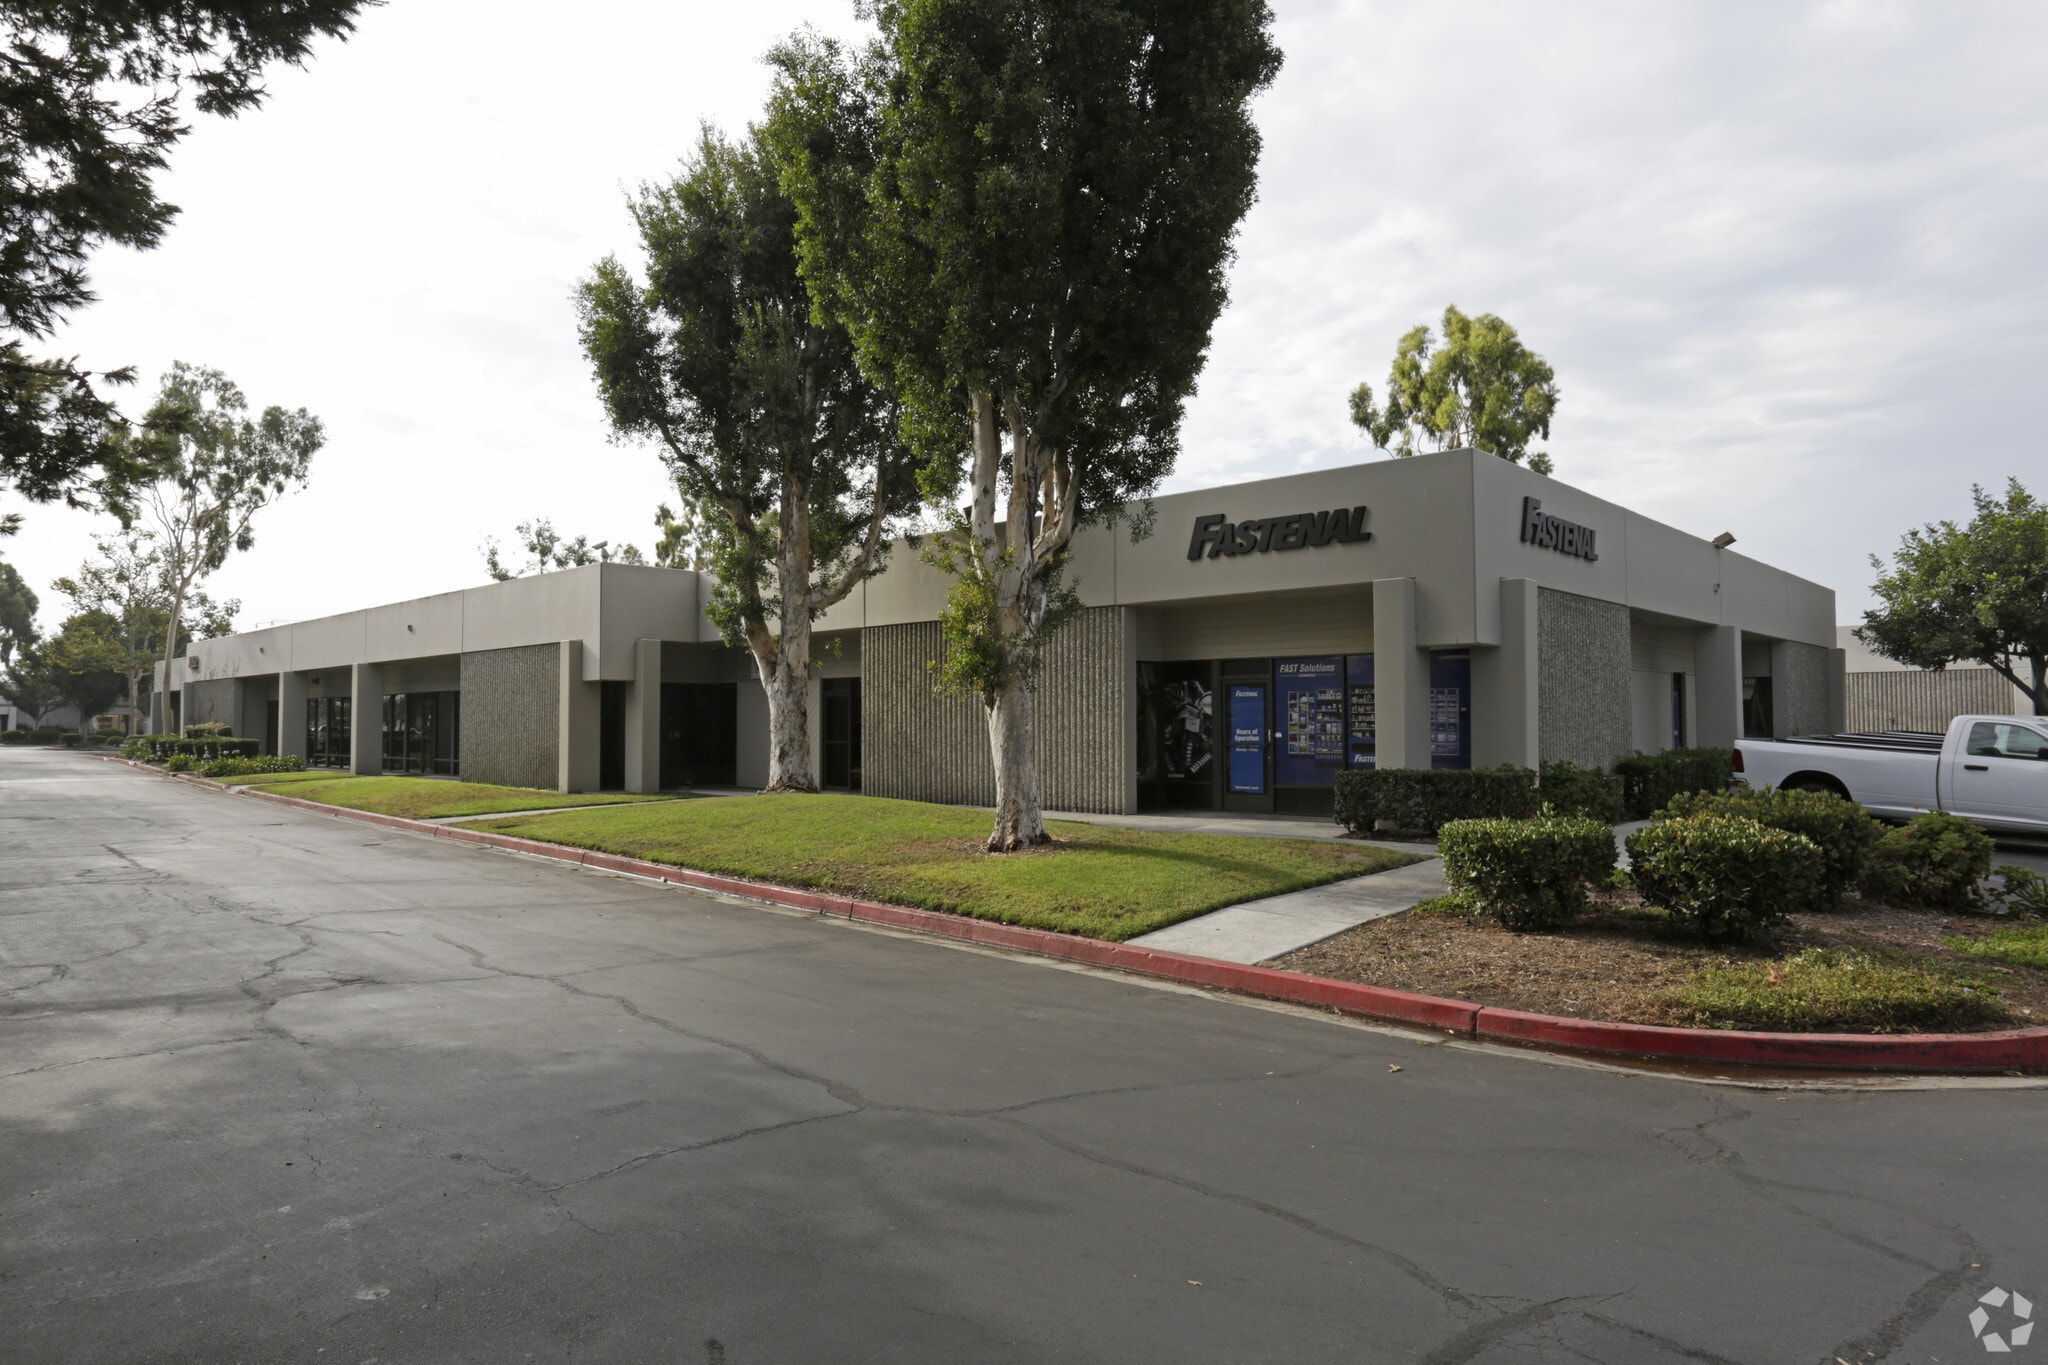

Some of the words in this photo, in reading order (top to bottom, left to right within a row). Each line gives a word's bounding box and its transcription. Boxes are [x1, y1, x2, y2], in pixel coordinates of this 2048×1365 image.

[1187, 506, 1372, 561] FASTENAL
[1520, 496, 1598, 561] FASTENAL
[1279, 664, 1299, 673] FAST
[1299, 663, 1336, 673] Solutions
[1354, 754, 1376, 763] FASTE
